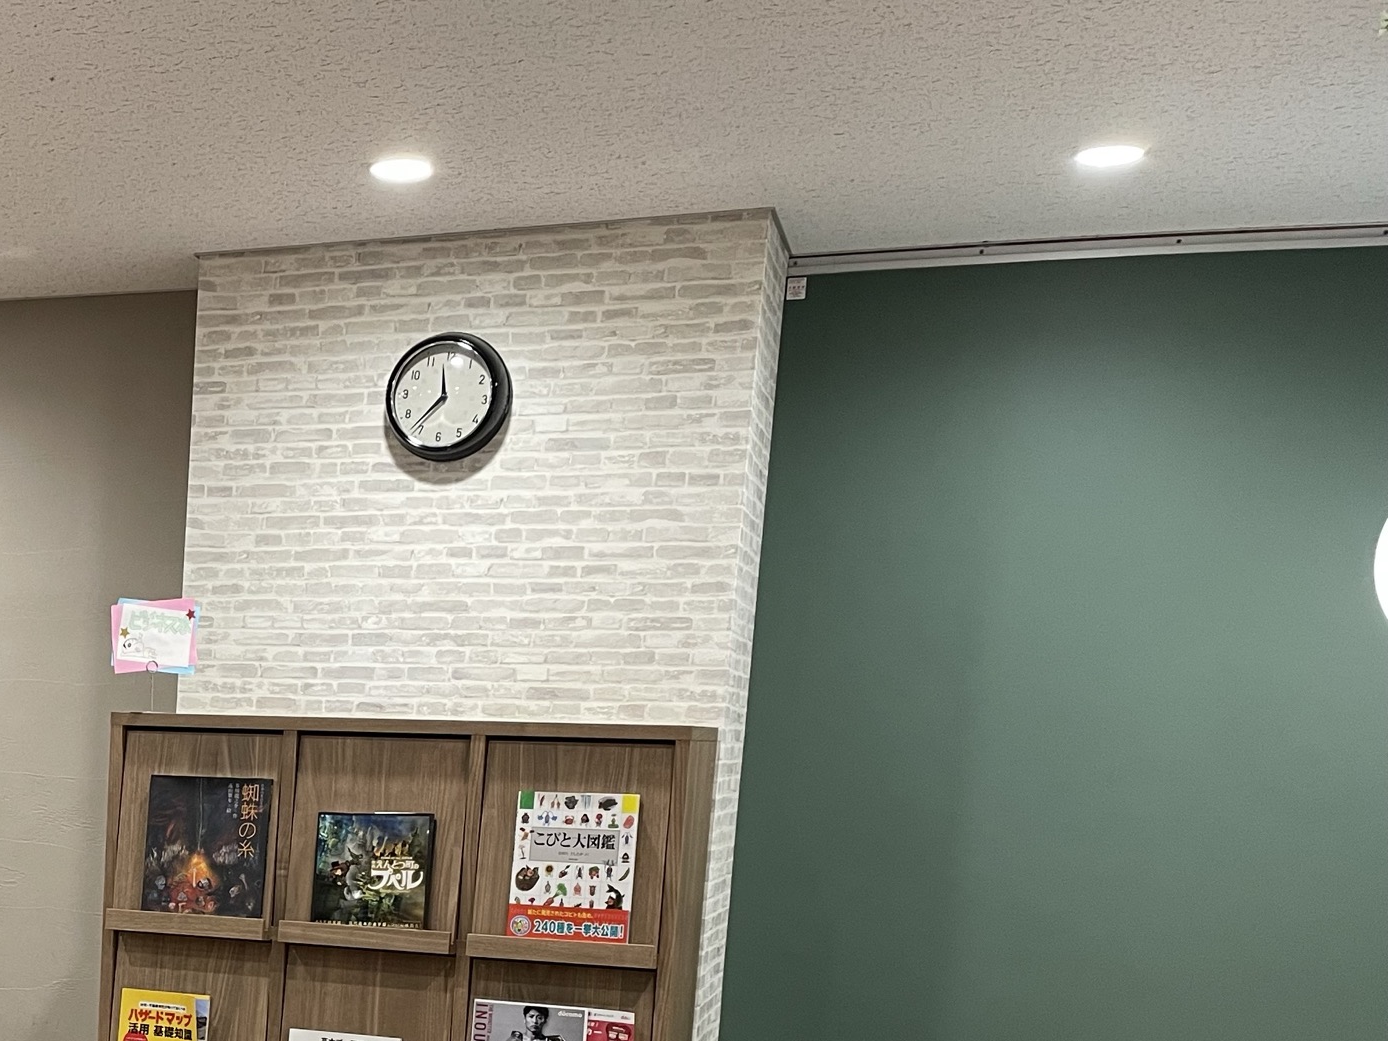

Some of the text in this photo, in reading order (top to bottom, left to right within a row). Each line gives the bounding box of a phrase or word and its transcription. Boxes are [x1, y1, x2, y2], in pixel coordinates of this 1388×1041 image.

[427, 356, 435, 367] 11
[411, 370, 420, 380] 10
[479, 374, 485, 385] 2
[481, 395, 488, 405] 3
[405, 409, 411, 419] 8
[472, 414, 479, 424] 4
[435, 432, 442, 442] 6
[456, 428, 462, 438] 5
[238, 783, 260, 858] 蜘蛛の糸
[533, 832, 616, 850] こびと大図鑑
[367, 869, 424, 890] プペル
[128, 1008, 192, 1027] ハザードマップ
[128, 1022, 150, 1036] 活用
